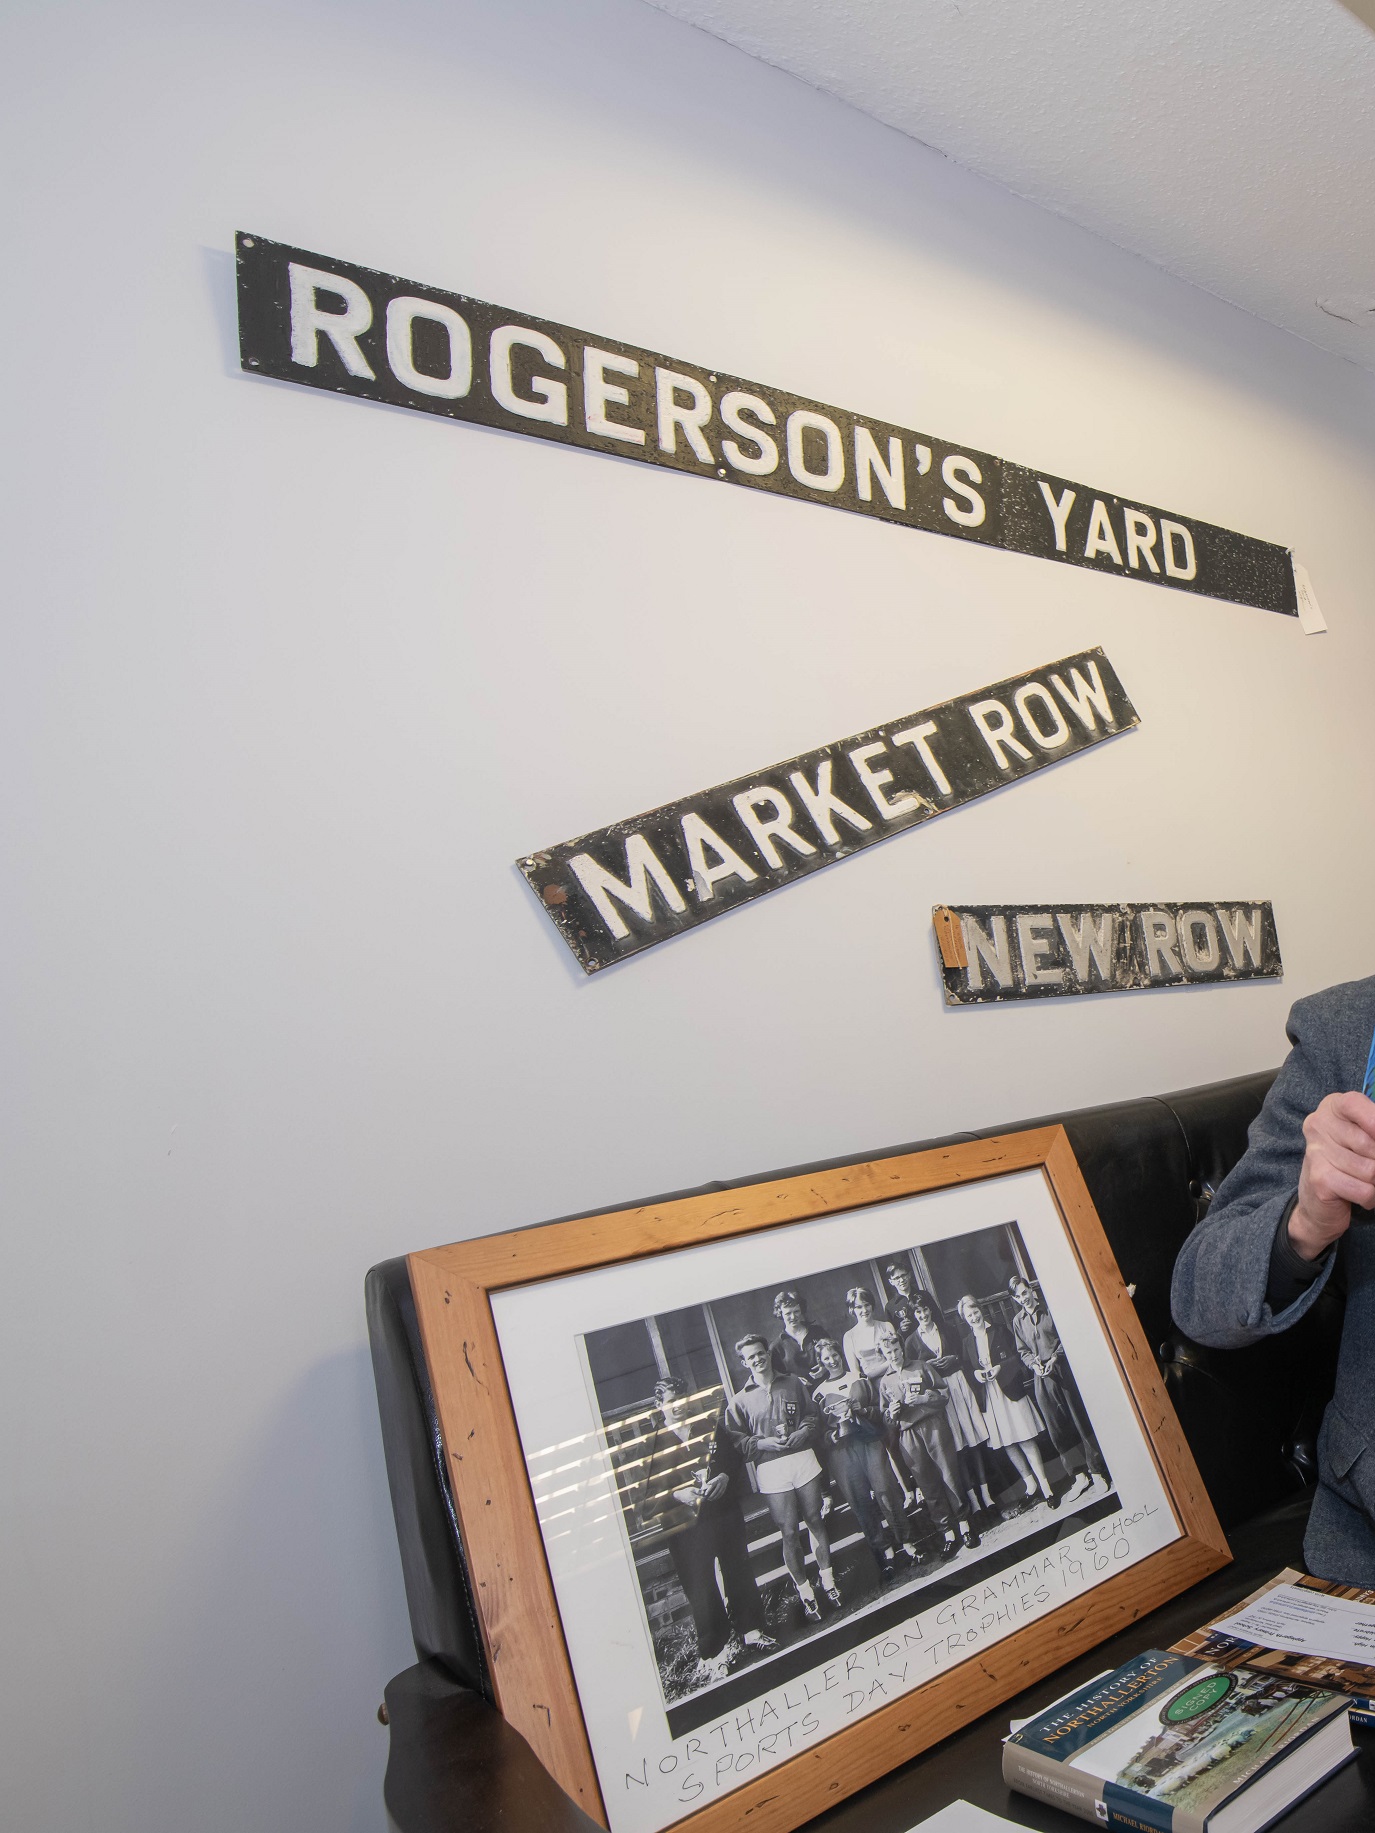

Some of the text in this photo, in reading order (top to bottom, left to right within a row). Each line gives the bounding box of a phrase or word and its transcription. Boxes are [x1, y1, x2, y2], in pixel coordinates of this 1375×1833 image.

[289, 262, 1198, 582] ROGERSON'S YARD
[565, 660, 1119, 943] MARKET ROW
[961, 911, 1112, 990] NEW
[1142, 908, 1265, 978] ROW
[625, 1504, 1160, 1791] NORTHALLERTON GRAMMAR SCHOOL
[1233, 1621, 1254, 1631] School
[1255, 1627, 1275, 1637] Primary
[678, 1537, 1132, 1803] SPORTS DAY TROPHIES 1960
[1039, 1657, 1158, 1732] THE HISTORY OF
[1042, 1656, 1180, 1744] NORTHALLERTON
[1174, 1681, 1217, 1716] SIGNED
[1189, 1688, 1218, 1712] COPY
[1086, 1708, 1118, 1729] NORTH
[1118, 1677, 1163, 1708] YORKSHIRE
[1232, 1717, 1320, 1785] MICHAEL RIORDAN
[1026, 1768, 1043, 1780] HISTORY
[1043, 1774, 1049, 1782] OF
[1050, 1777, 1085, 1798] NORTHALLERTON
[1031, 1778, 1070, 1799] NORTH YORKSHIRE
[1112, 1812, 1139, 1829] MICHAEL
